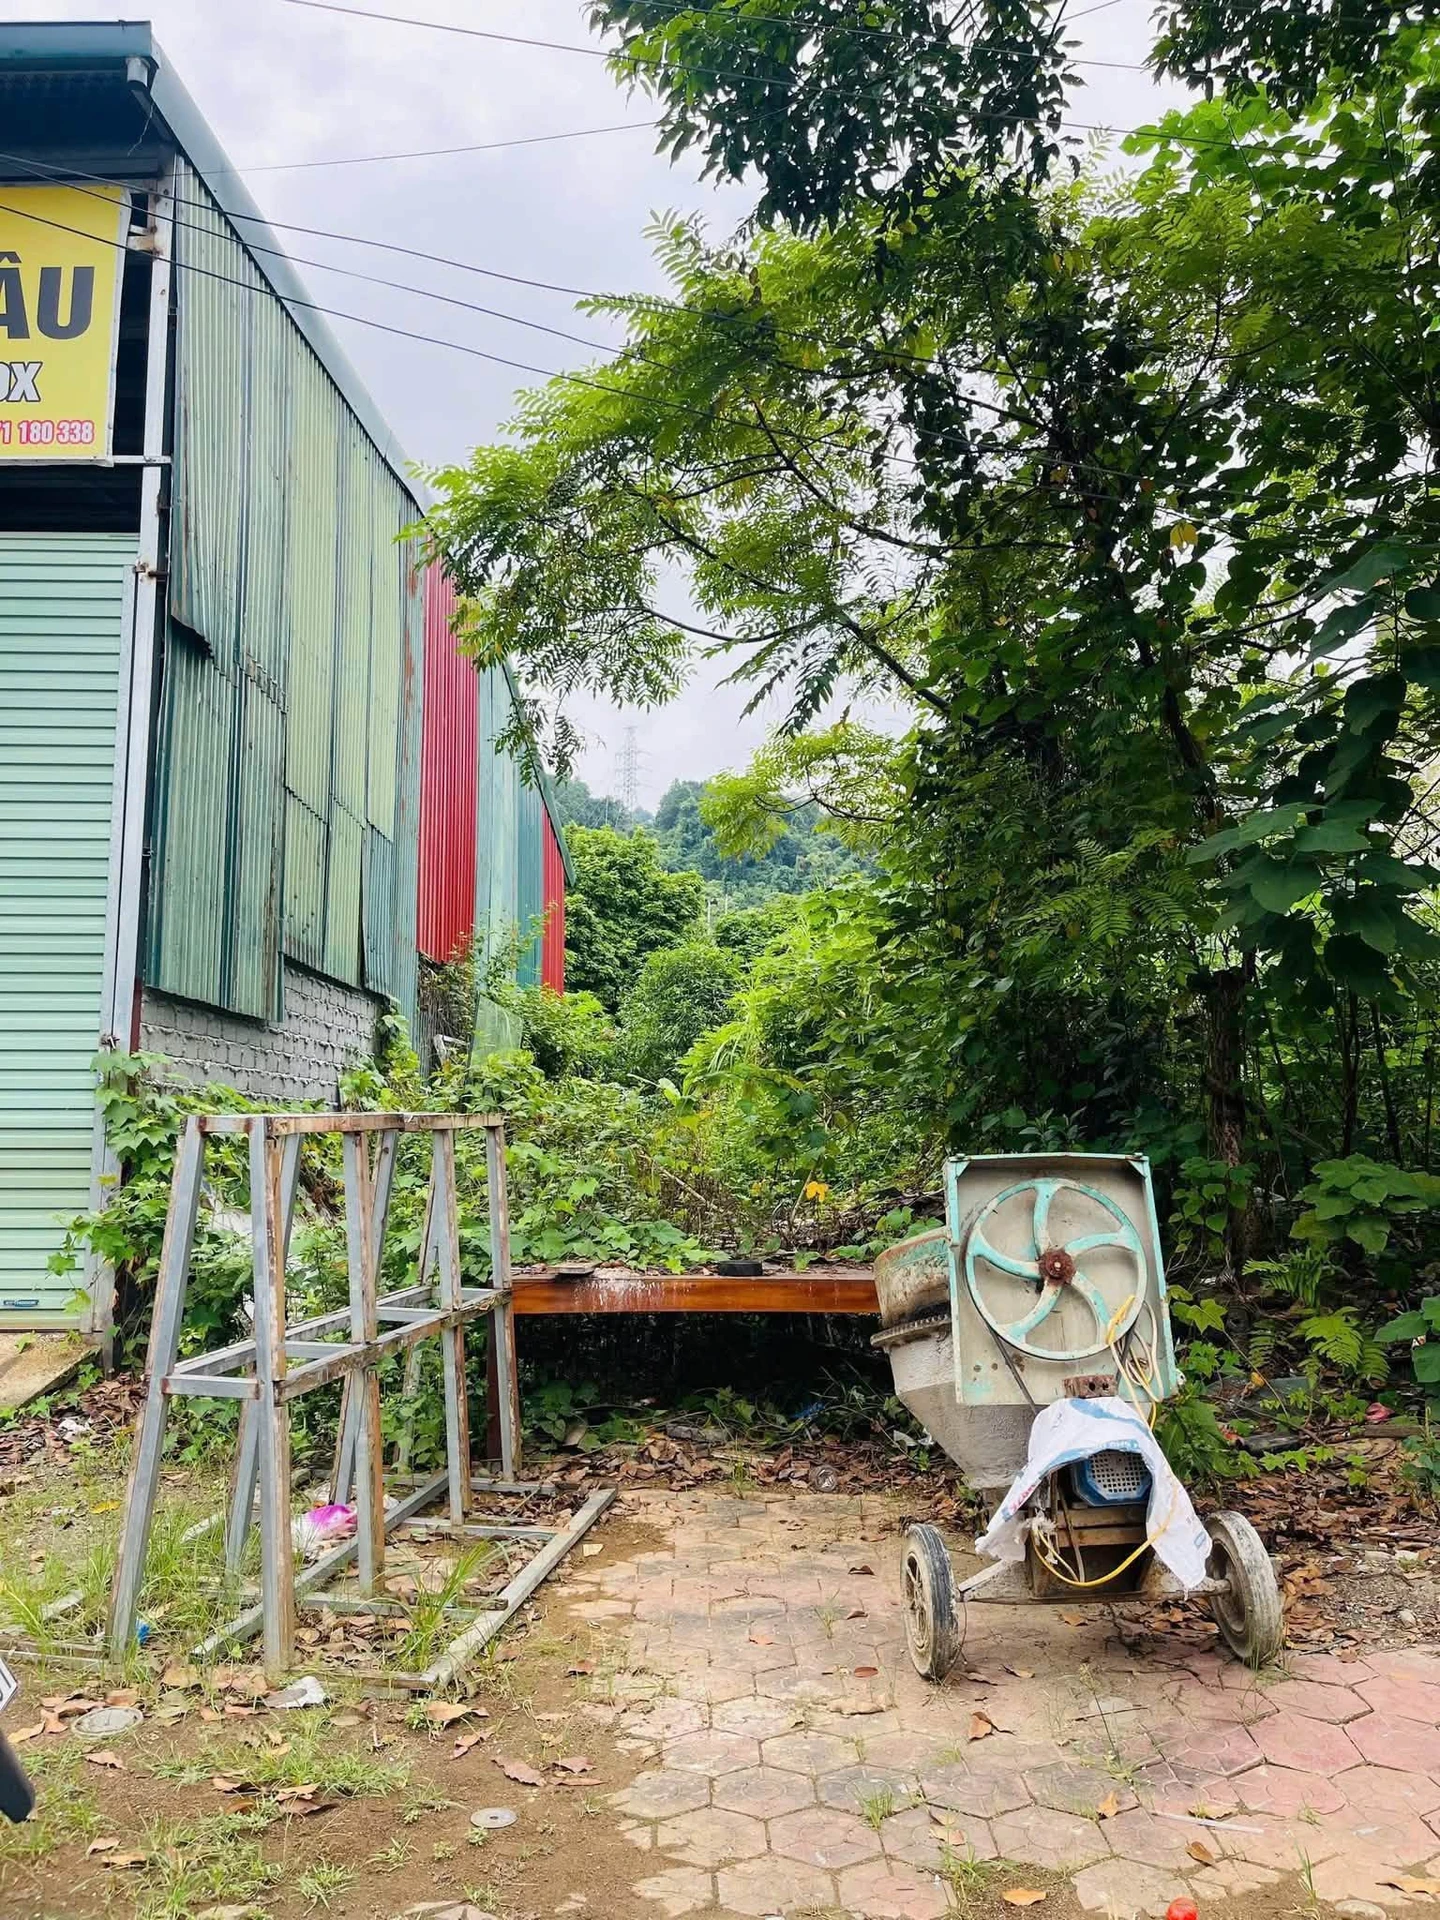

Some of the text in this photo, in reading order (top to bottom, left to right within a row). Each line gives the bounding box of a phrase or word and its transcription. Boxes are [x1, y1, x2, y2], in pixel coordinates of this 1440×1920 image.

[0, 420, 94, 444] 1 180 338
